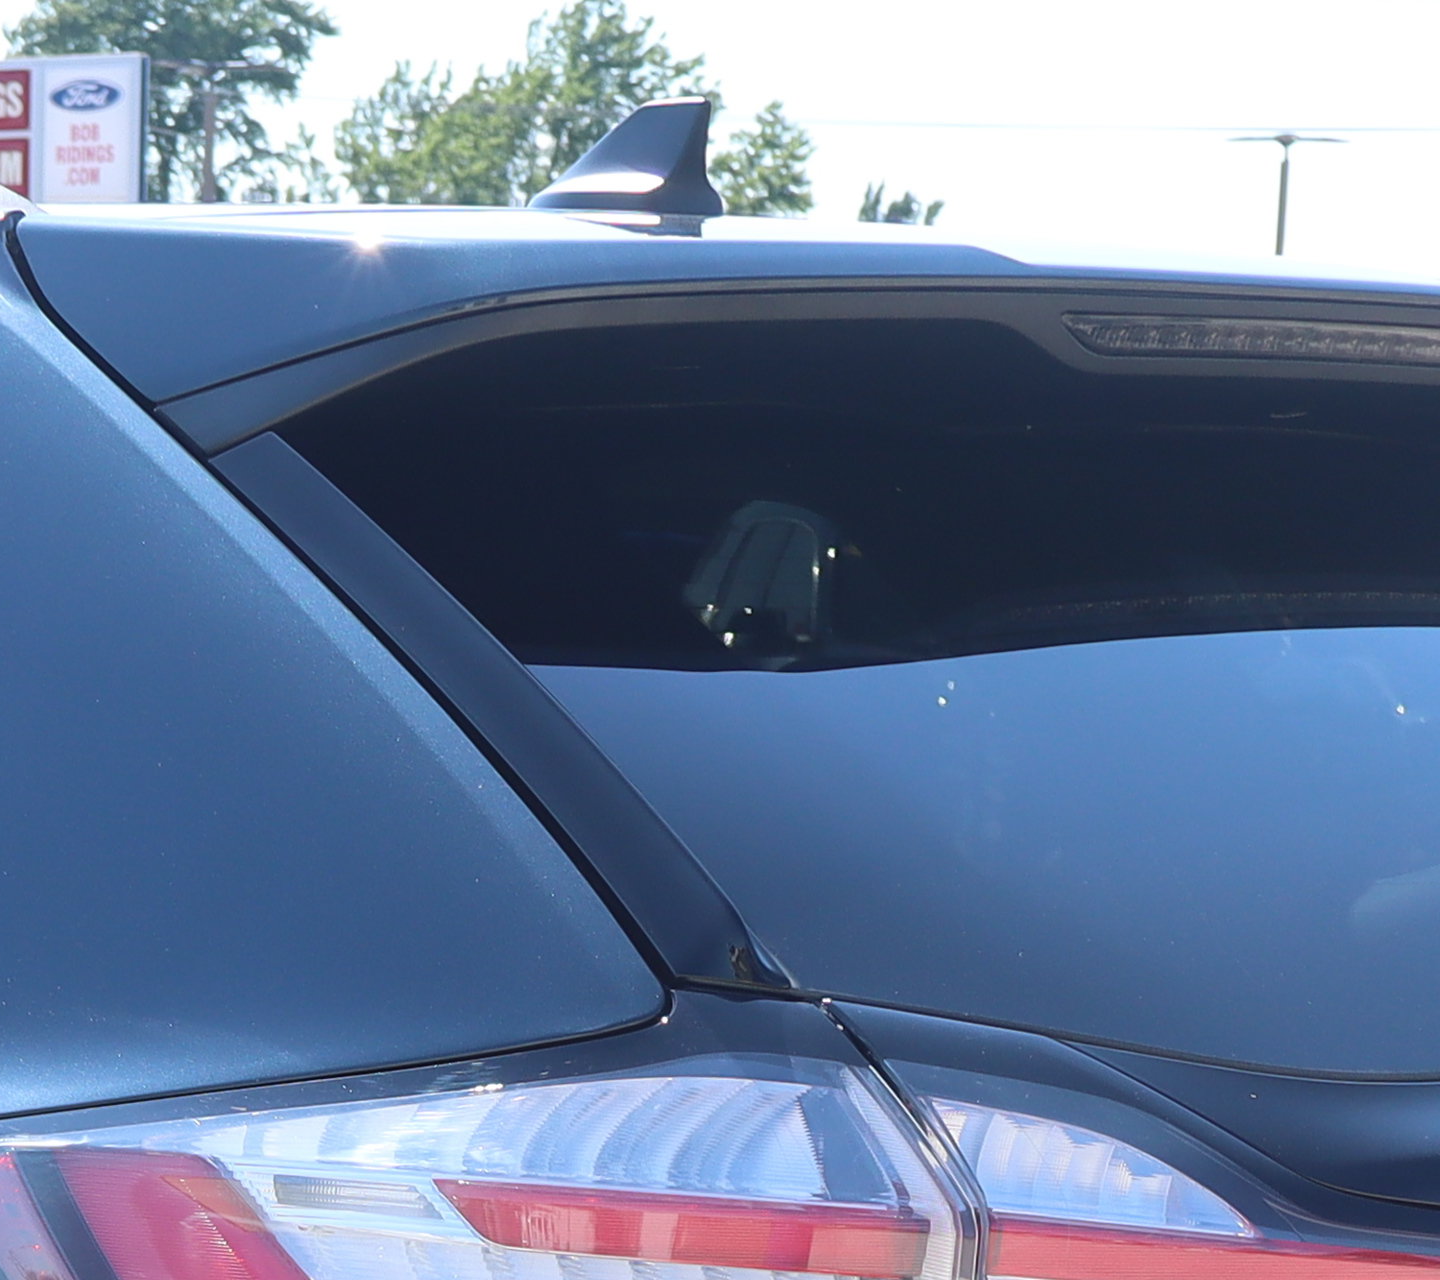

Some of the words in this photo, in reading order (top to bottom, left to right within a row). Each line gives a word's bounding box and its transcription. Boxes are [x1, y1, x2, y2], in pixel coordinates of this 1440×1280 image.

[69, 123, 100, 142] BOB
[55, 145, 115, 164] RIDINGS
[64, 167, 100, 186] .COM
